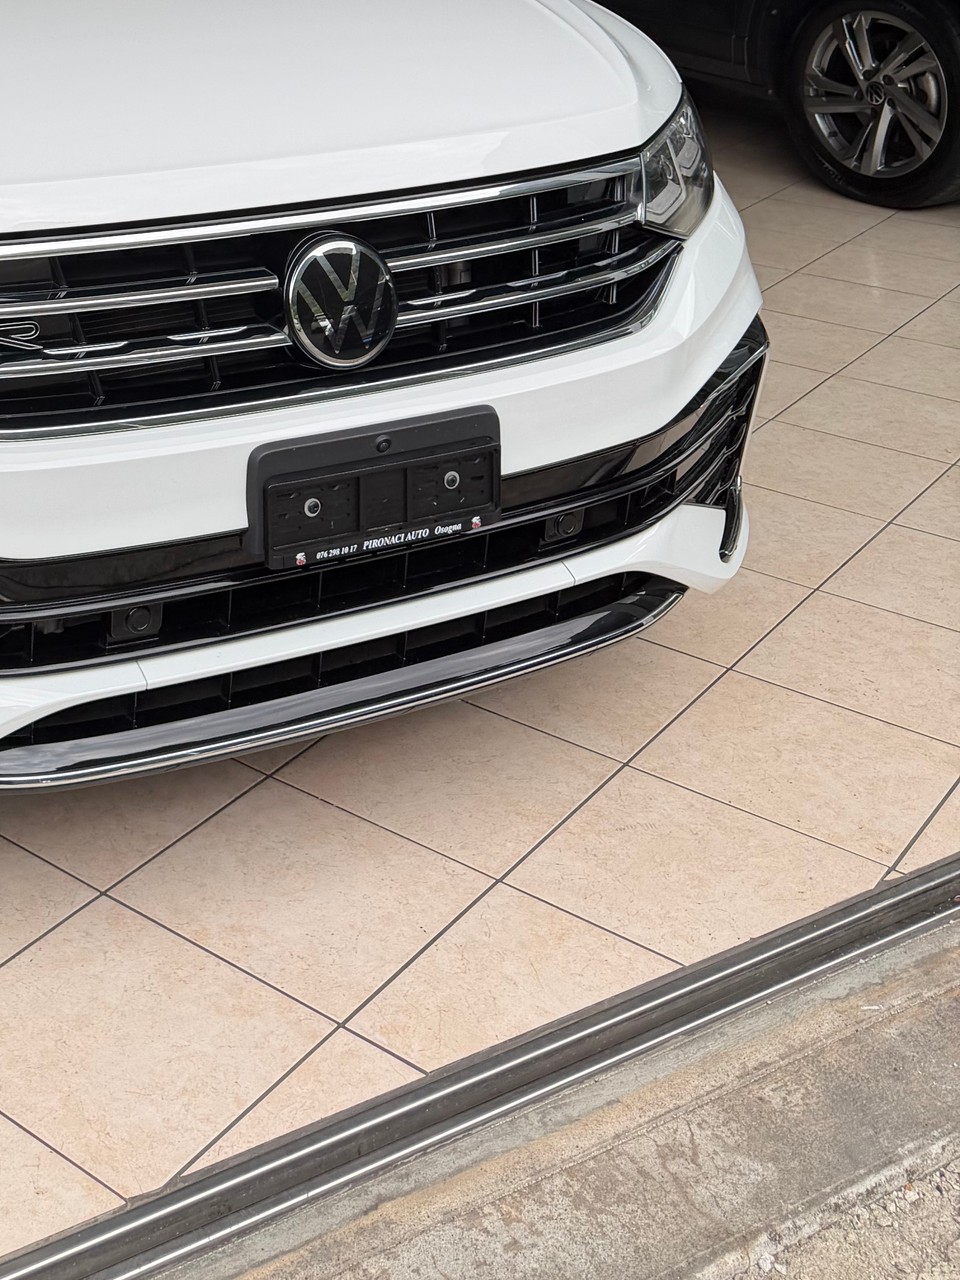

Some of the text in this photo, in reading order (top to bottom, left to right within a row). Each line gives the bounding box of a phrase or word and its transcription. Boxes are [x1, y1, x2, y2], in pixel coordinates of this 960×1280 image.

[290, 238, 394, 365] VW
[316, 523, 462, 560] 076 298 10 17 PIRONACI AUTO Osogna
